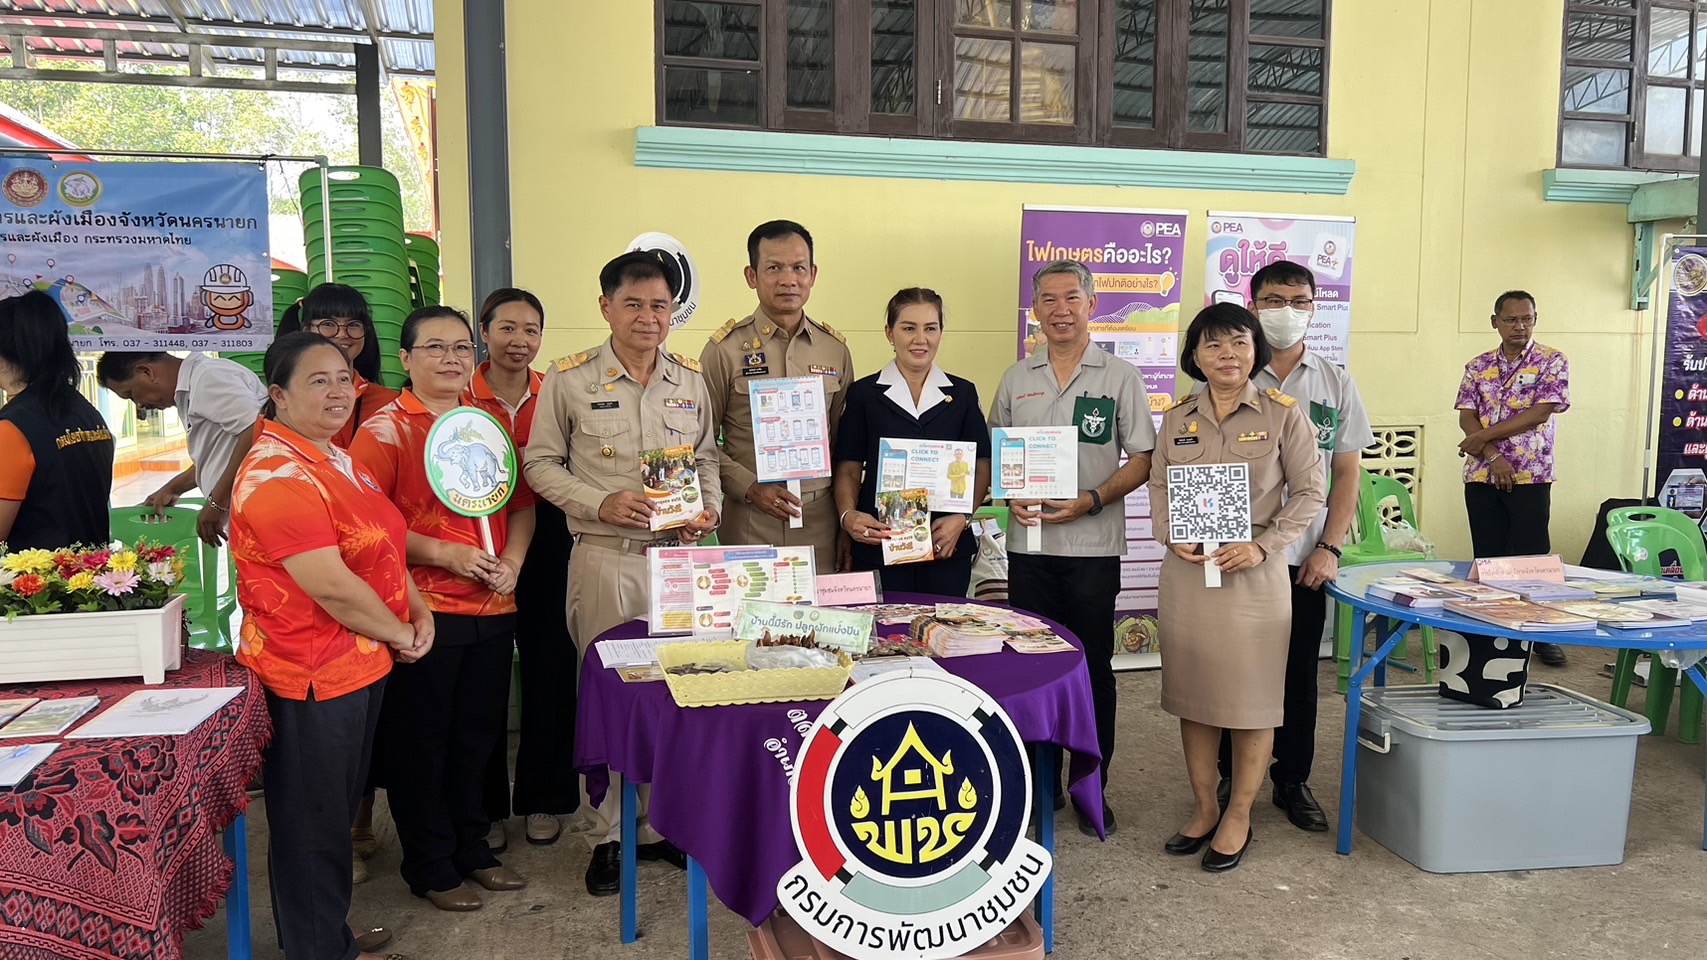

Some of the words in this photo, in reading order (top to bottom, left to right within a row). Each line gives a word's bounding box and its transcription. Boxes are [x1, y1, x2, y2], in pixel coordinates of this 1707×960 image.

[1156, 223, 1181, 237] PEA
[1223, 222, 1244, 233] PEA
[84, 232, 192, 245] กระทรวงมหาดไทย
[1026, 240, 1173, 265] ไฟเกษตรคืออะไร?
[1317, 255, 1331, 265] PEA
[1316, 303, 1336, 311] Smart
[153, 340, 188, 348] 311448,
[221, 340, 253, 348] 311803
[1323, 335, 1338, 343] Plus
[783, 852, 1045, 951] กรมการพัฒนาชุมชน
